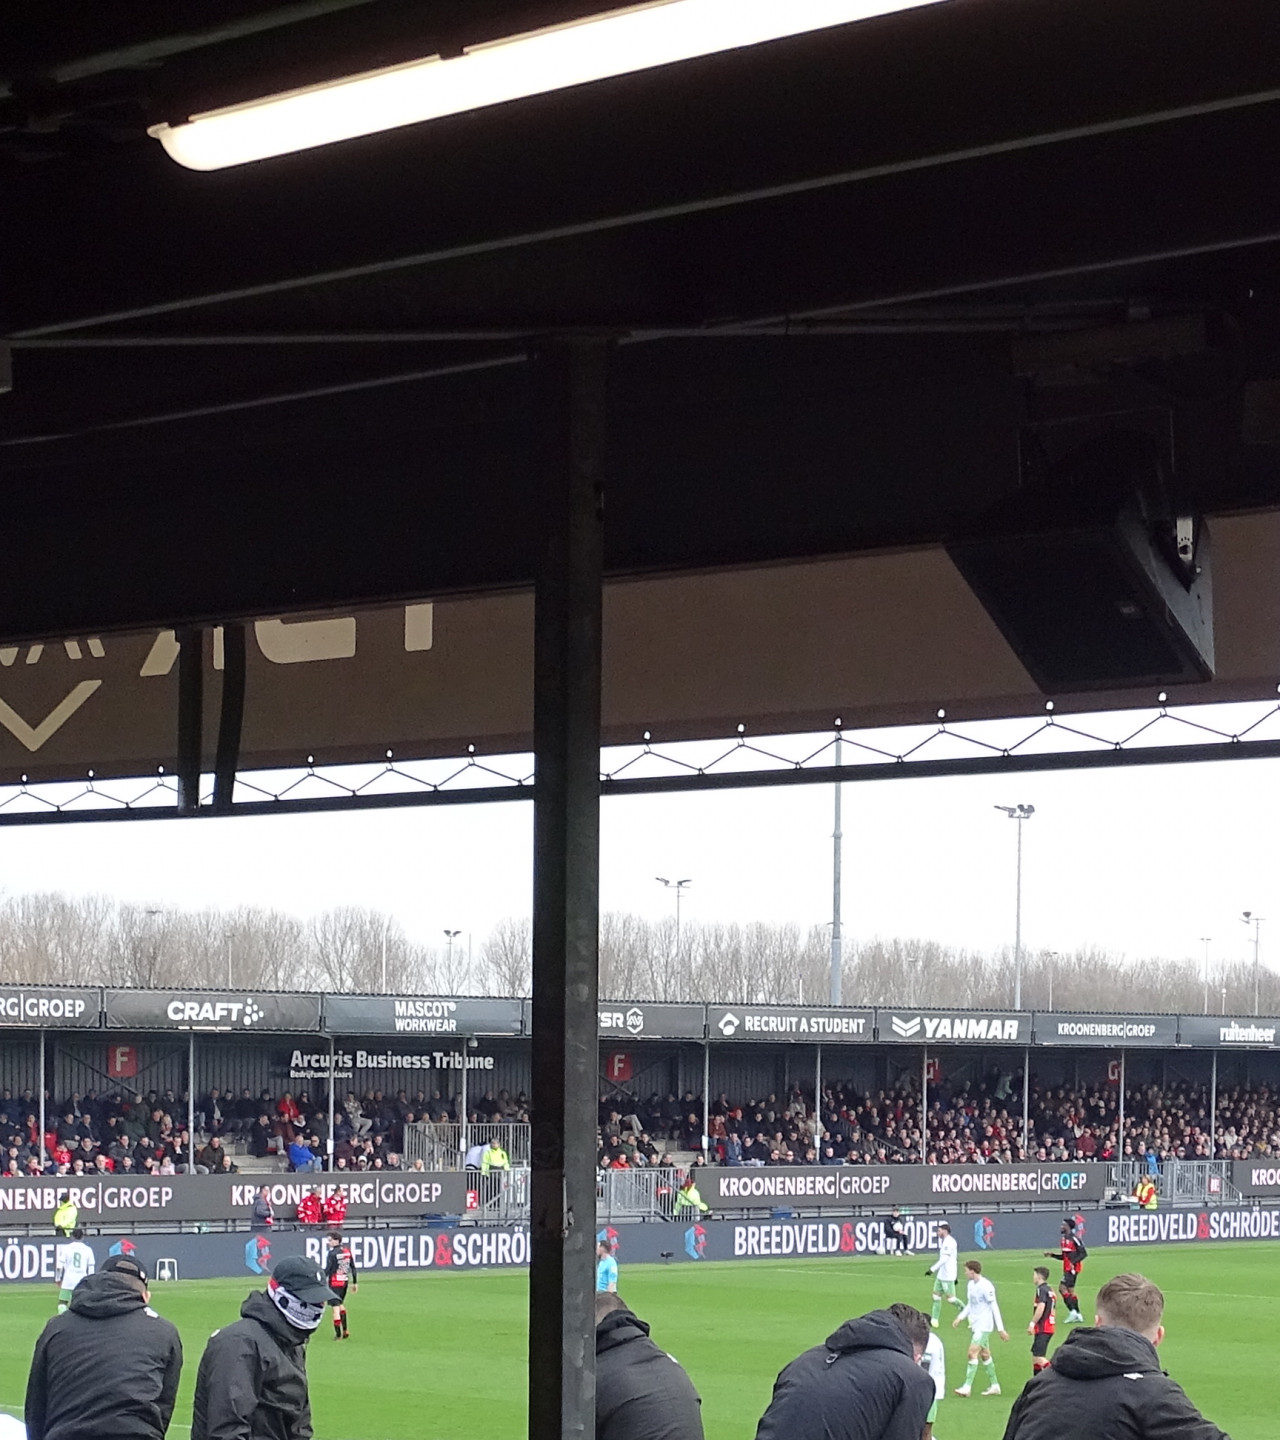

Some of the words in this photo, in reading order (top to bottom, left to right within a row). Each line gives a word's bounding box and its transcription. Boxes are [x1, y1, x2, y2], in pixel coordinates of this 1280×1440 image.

[25, 998, 86, 1018] GROEP
[167, 1000, 243, 1022] CRAFT
[394, 1018, 457, 1032] WORKWEAR
[598, 1011, 624, 1028] SR
[744, 1015, 797, 1032] RECRUIT
[799, 1017, 809, 1033] A
[810, 1018, 866, 1034] STUDENT
[923, 1017, 1019, 1039] YANMAR
[1057, 1022, 1123, 1036] KROONENBERG
[1126, 1023, 1156, 1038] GROEP
[115, 1046, 129, 1072] F
[290, 1050, 353, 1068] Arcuris
[356, 1051, 431, 1069] Business
[433, 1052, 495, 1071] Tribune
[613, 1054, 626, 1077] F
[719, 1175, 835, 1197] KROONENBERG
[840, 1175, 890, 1195] GROEP
[931, 1172, 1038, 1192] KROONENBERG
[1041, 1172, 1087, 1190] GROEP
[104, 1186, 173, 1208] GROEP
[231, 1183, 375, 1206] KRONERG
[380, 1182, 442, 1203] GROEP
[73, 1252, 81, 1268] 8
